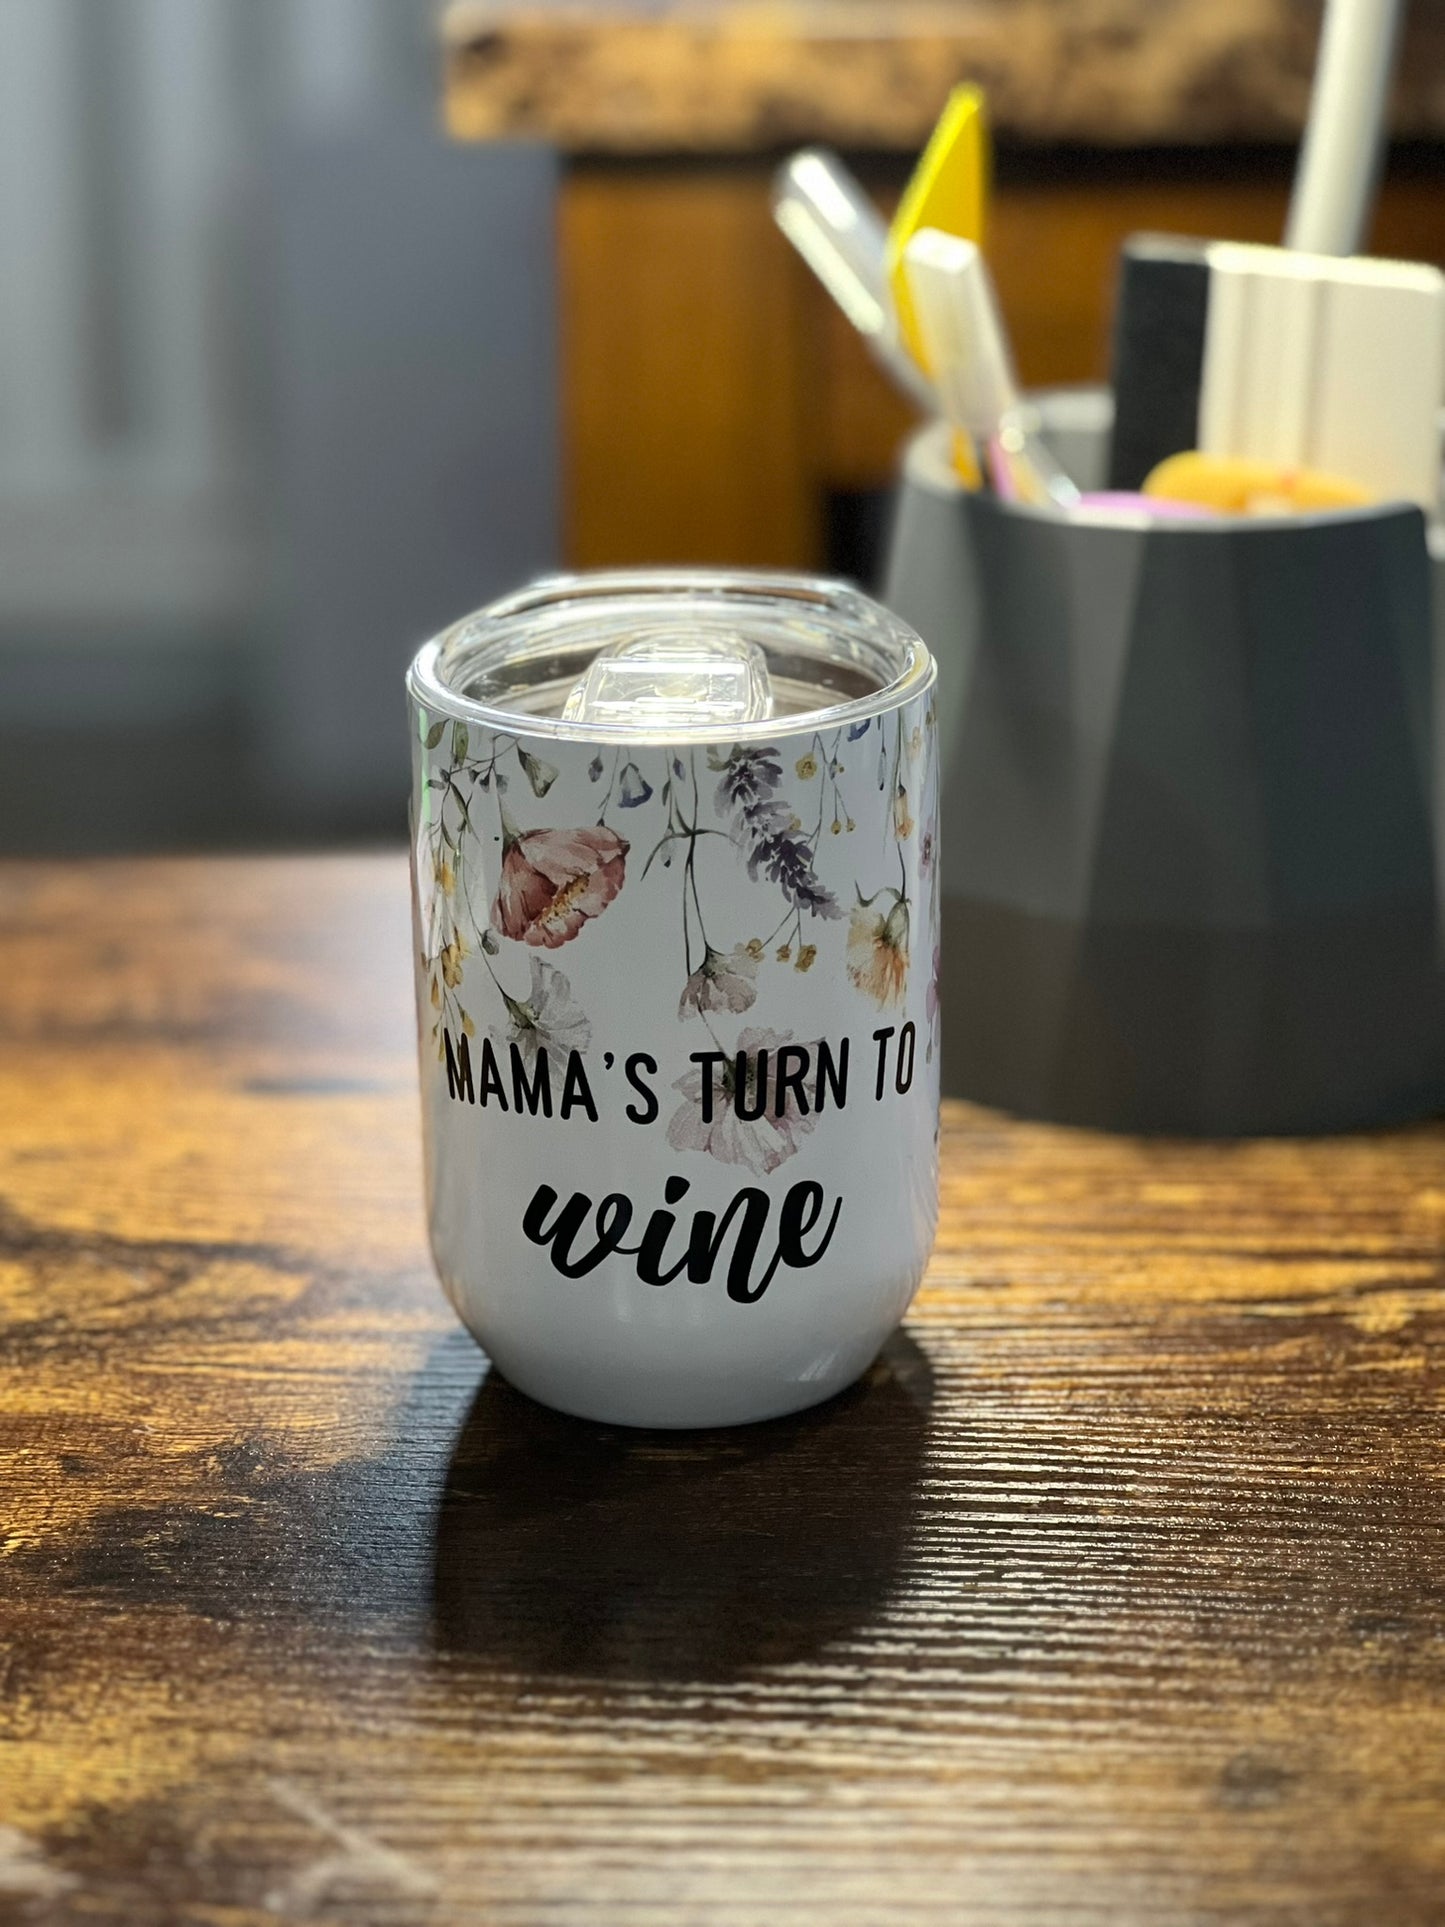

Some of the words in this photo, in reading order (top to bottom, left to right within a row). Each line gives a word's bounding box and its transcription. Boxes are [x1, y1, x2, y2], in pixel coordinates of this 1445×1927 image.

[443, 1027, 659, 1125] MAMA'S
[689, 1037, 850, 1124] TURN
[872, 1021, 916, 1102] TO
[522, 1175, 843, 1304] wine
